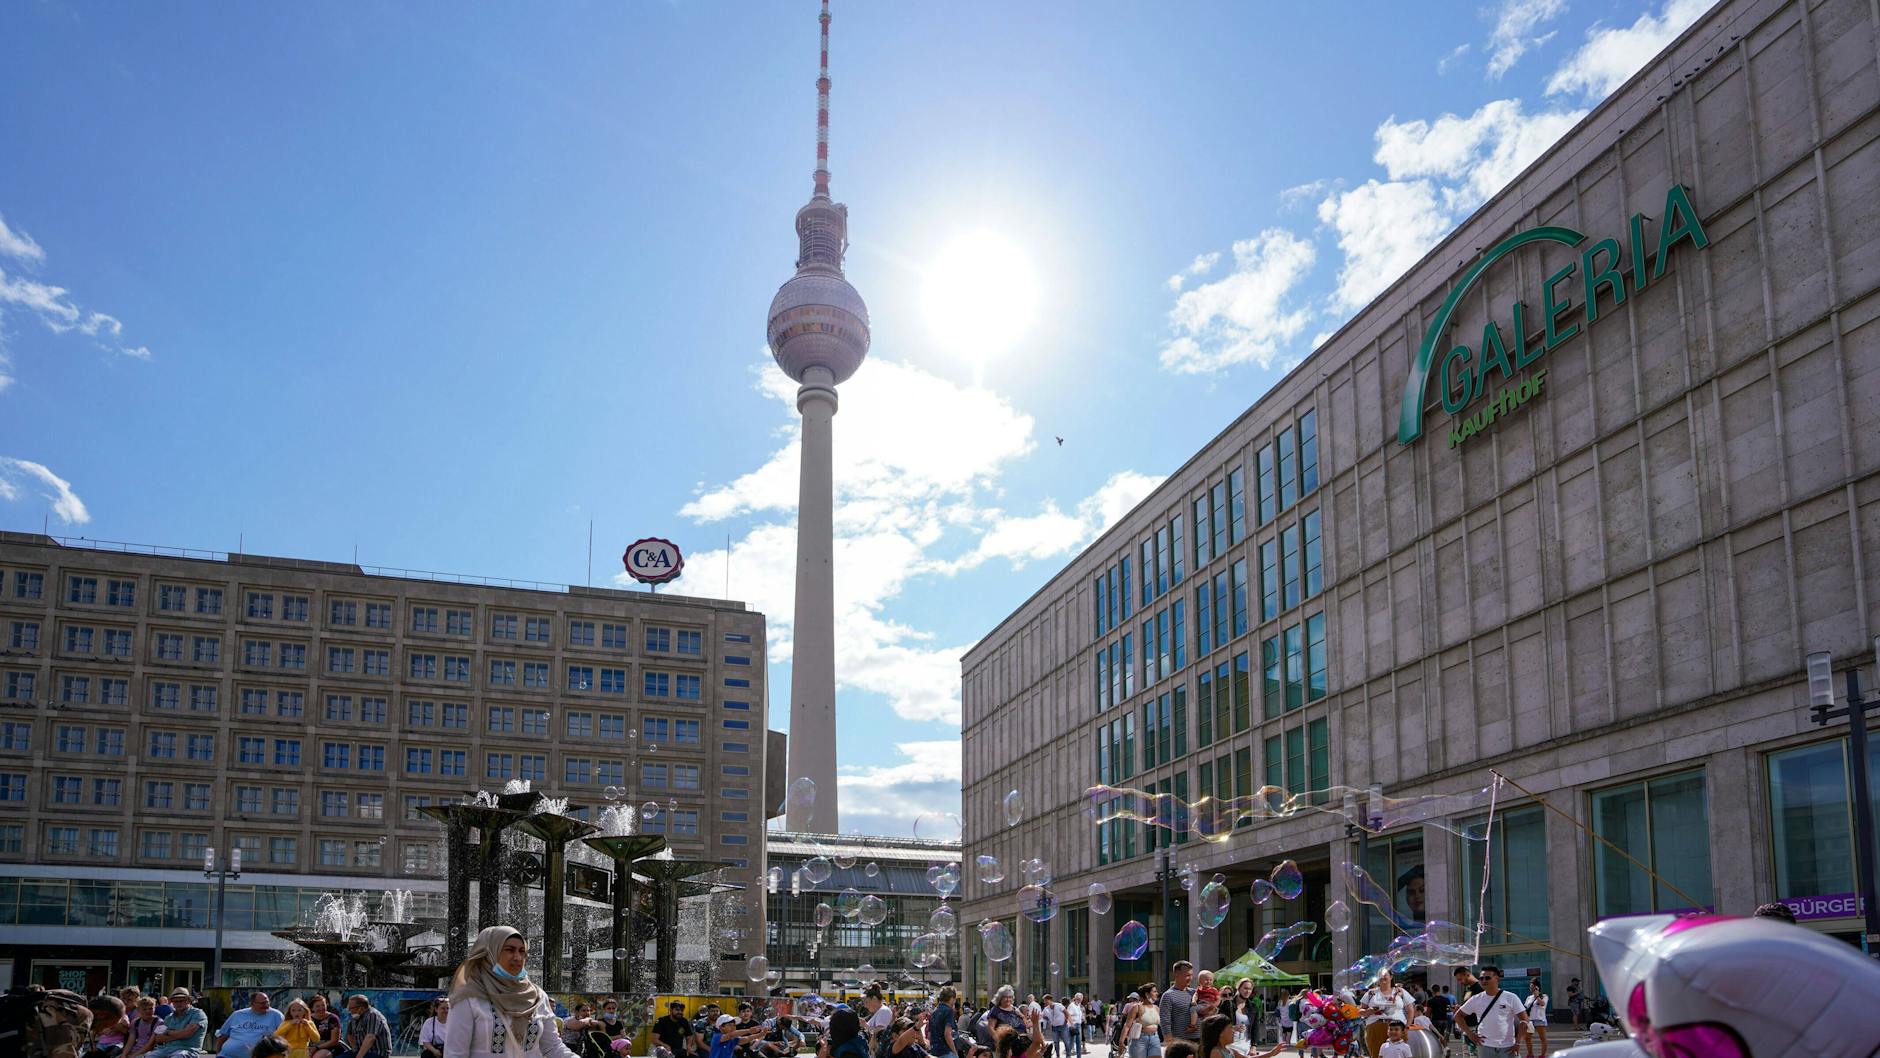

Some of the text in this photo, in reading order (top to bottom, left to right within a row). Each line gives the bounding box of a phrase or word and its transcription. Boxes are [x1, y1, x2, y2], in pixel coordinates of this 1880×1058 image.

[1440, 183, 1710, 415] GALERIA
[633, 548, 672, 568] C&A
[58, 977, 86, 989] YOU
